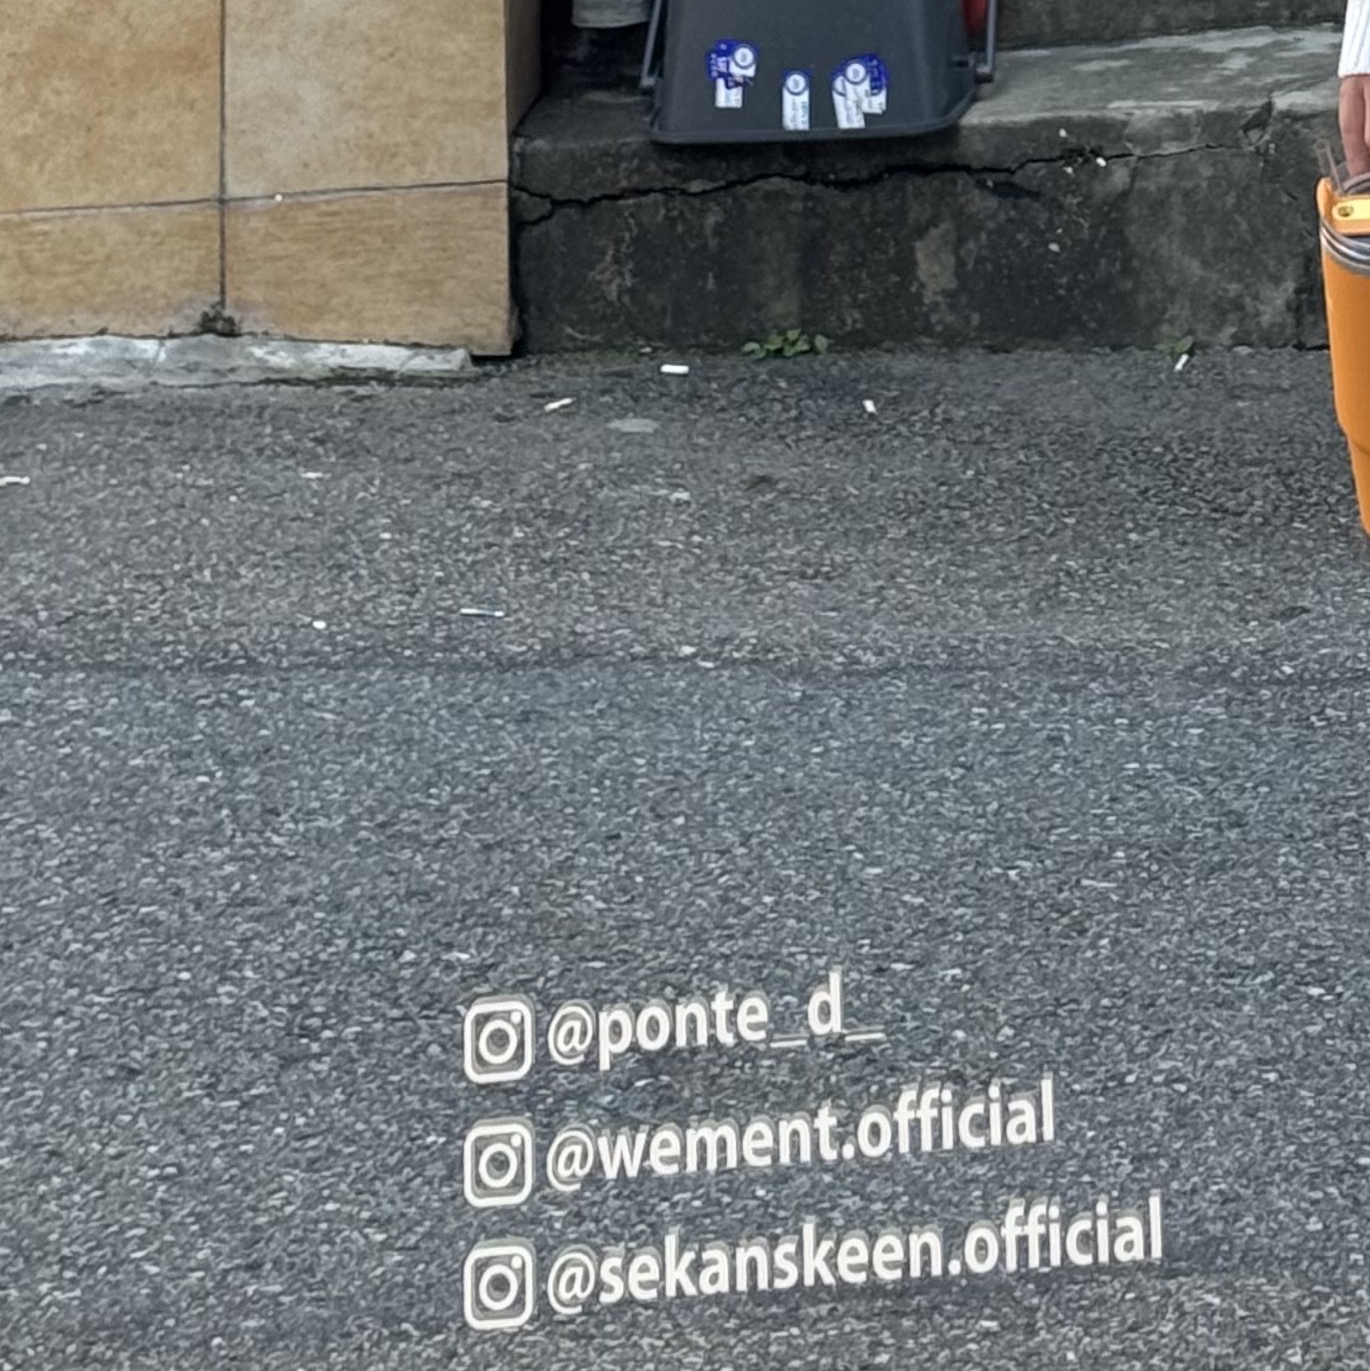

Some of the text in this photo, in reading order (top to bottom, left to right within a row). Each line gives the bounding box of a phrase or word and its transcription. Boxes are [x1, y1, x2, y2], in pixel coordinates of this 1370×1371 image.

[547, 968, 887, 1071] @ponte_d_
[546, 1076, 1056, 1192] @wement.official
[546, 1190, 1163, 1315] @sekanskeen.official
